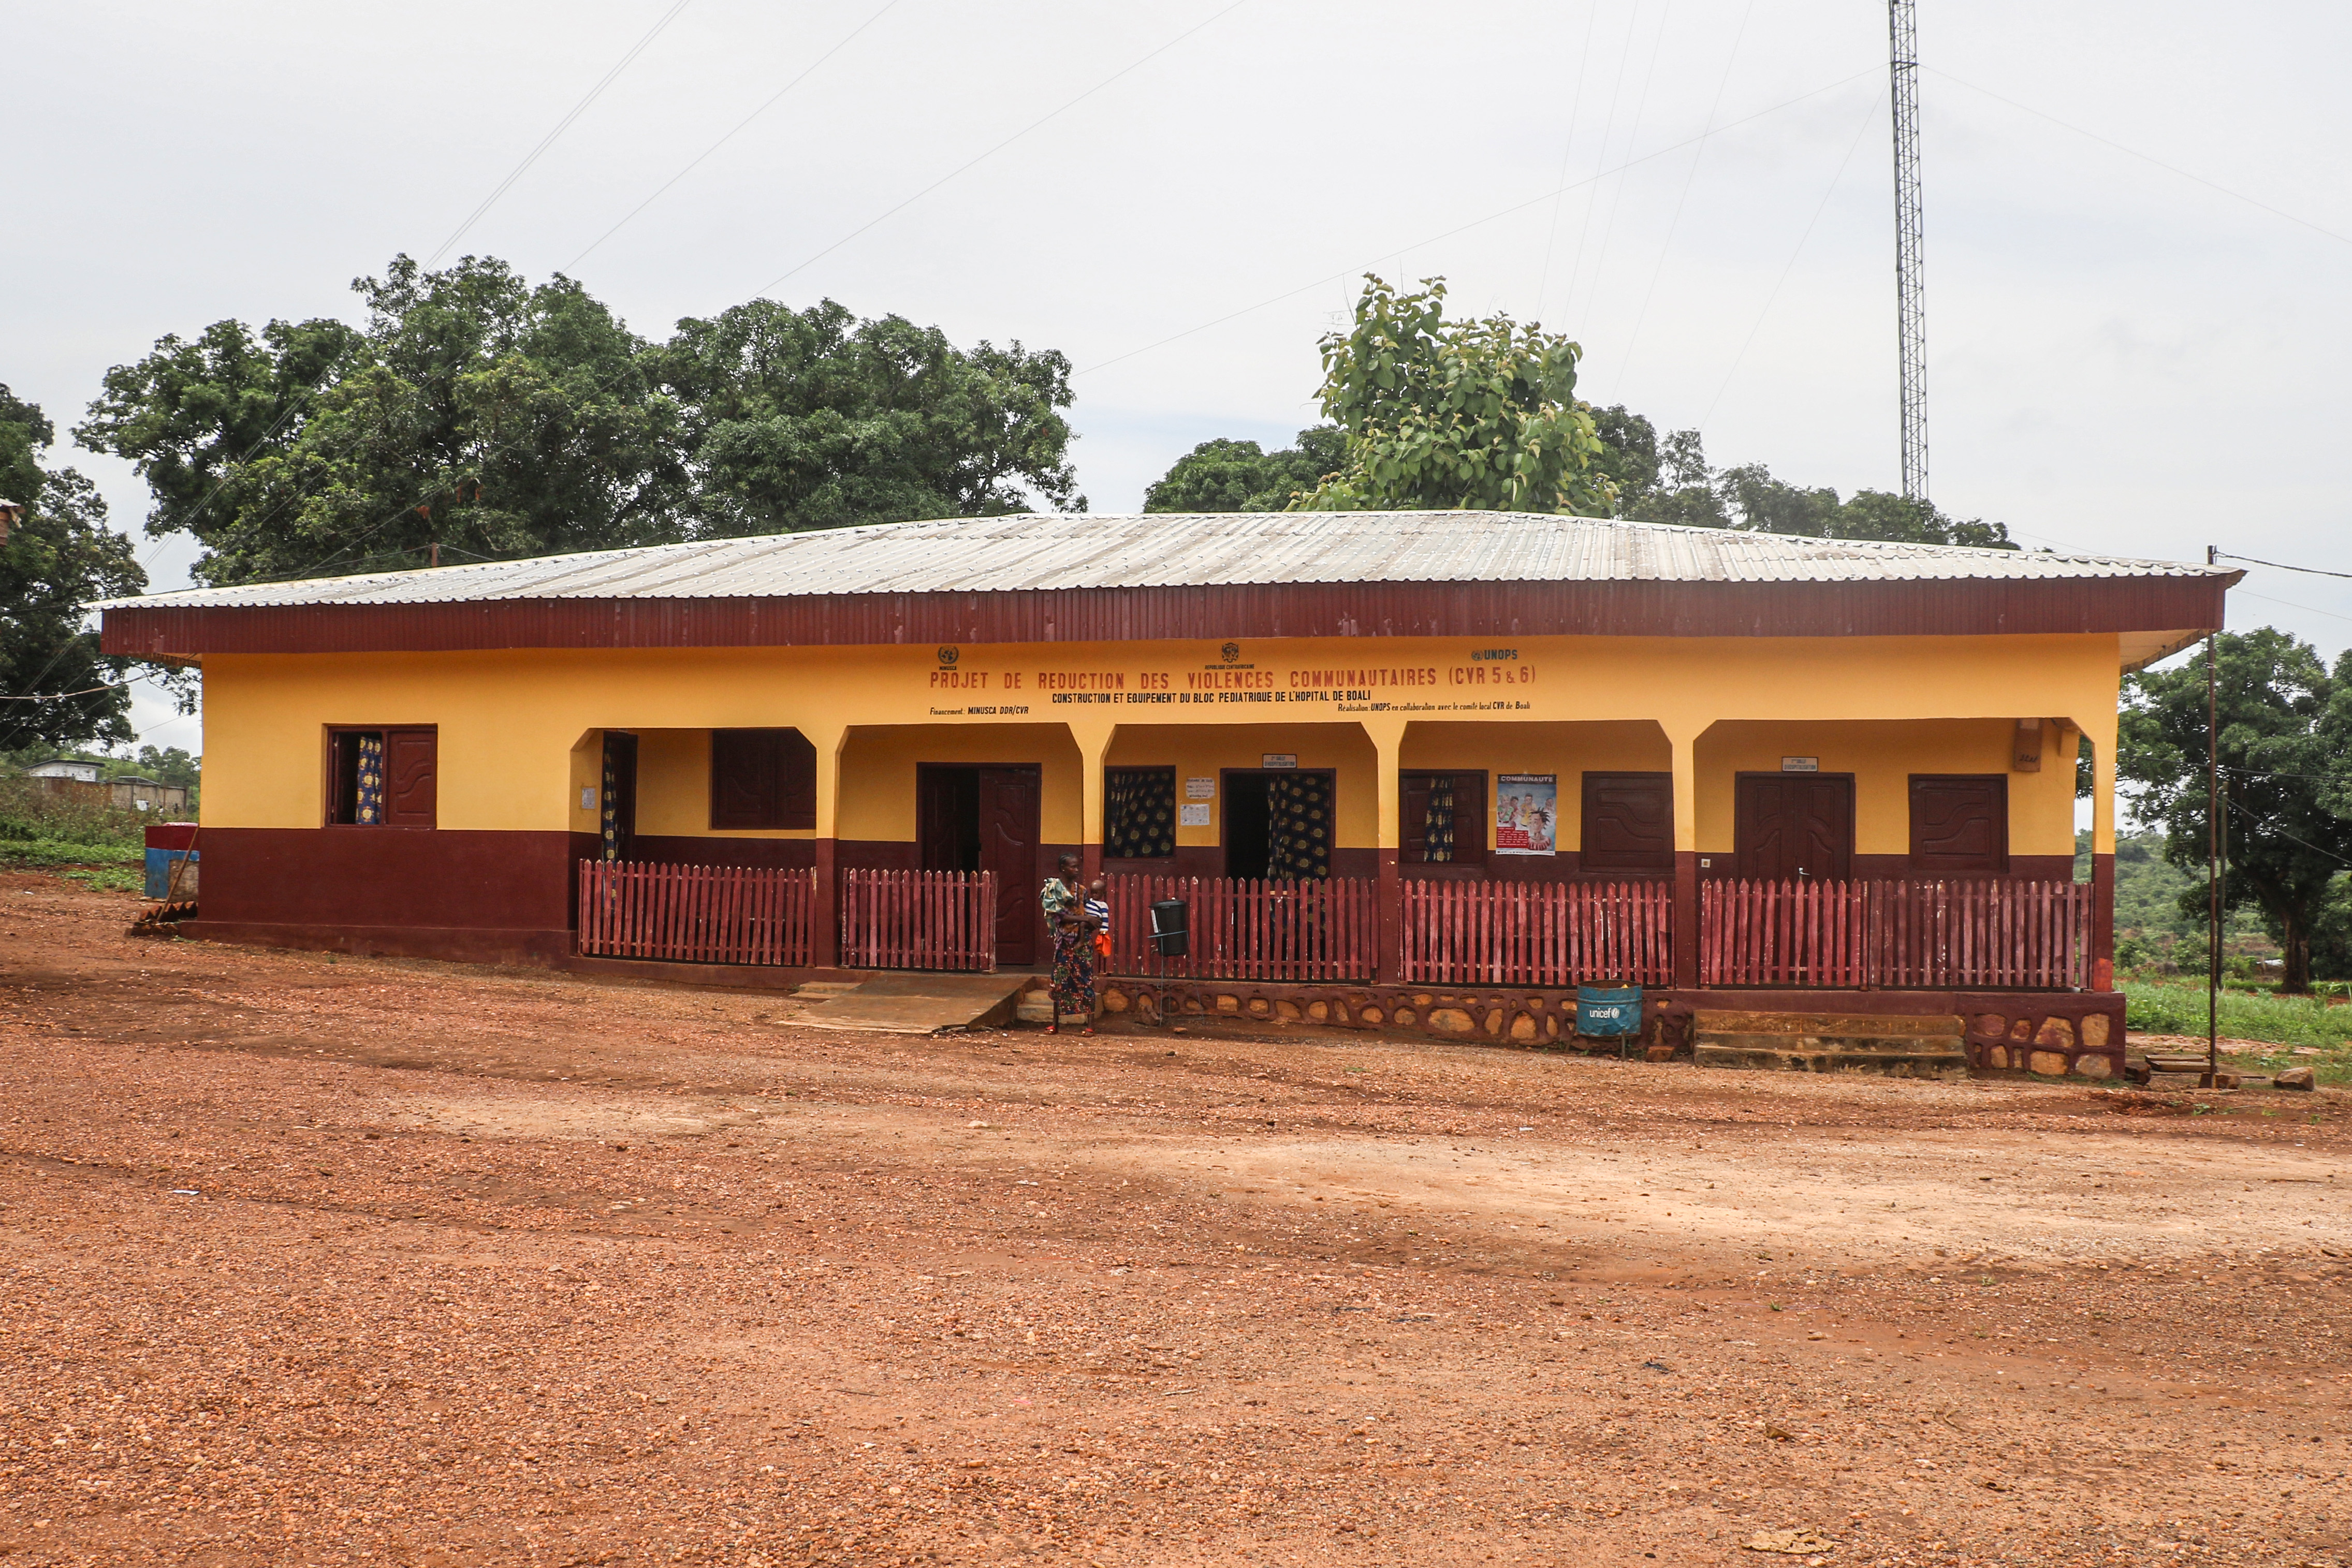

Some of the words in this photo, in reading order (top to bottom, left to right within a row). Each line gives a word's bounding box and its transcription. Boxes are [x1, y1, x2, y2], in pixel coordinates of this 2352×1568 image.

[1484, 649, 1518, 660] UNOPS
[930, 672, 988, 688] PROJET
[1004, 672, 1021, 689] DE
[1039, 672, 1124, 690] REDUCTION
[1141, 672, 1169, 690] DES
[1188, 671, 1274, 689] VIOLENCES
[1290, 668, 1437, 688] COMMUNAUTAIRES
[1449, 666, 1485, 686] (CVR
[1492, 666, 1501, 684] 5
[1506, 671, 1516, 684] &
[1520, 665, 1536, 684] 6)
[1053, 693, 1111, 704] CONSTRUCTION
[1114, 693, 1124, 703] ET
[1127, 693, 1177, 704] EQUIPEMENT
[1180, 693, 1191, 703] DU
[1193, 692, 1215, 703] BLOC
[1219, 692, 1272, 702] PEDIATRIQUE
[1275, 692, 1286, 702] DE
[1289, 690, 1330, 702] L'HOPITAL
[1333, 691, 1343, 701] DE
[1347, 690, 1371, 701] BOALI
[968, 706, 997, 715] MINUSCA
[1000, 705, 1029, 716] DDR/CVR
[1371, 702, 1391, 711] UNOPS
[1400, 702, 1435, 711] collaboration
[1453, 702, 1458, 710] le
[1460, 702, 1478, 710] comité
[1479, 701, 1492, 710] local
[1493, 701, 1504, 710] CVR
[1506, 701, 1513, 710] de
[1515, 701, 1531, 710] Boali
[1589, 1007, 1612, 1018] unicef
